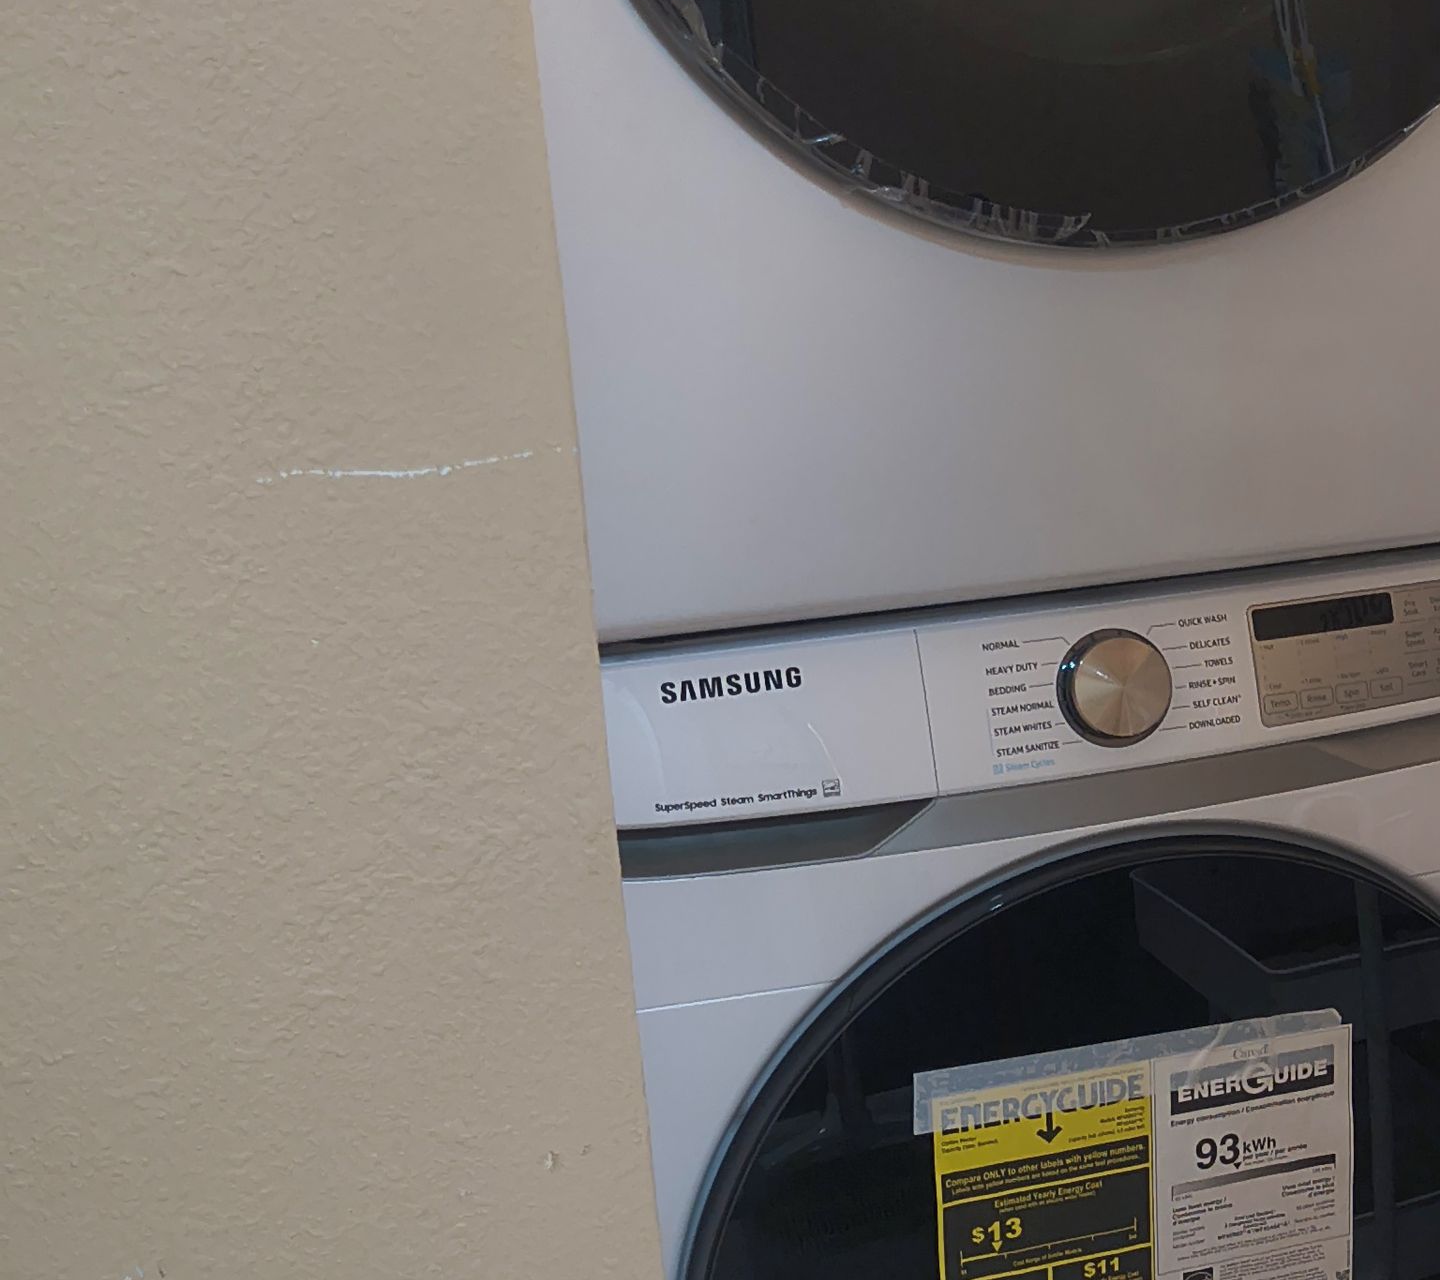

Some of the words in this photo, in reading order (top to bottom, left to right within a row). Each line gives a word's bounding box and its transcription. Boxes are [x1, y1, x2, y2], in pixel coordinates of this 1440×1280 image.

[1178, 617, 1202, 628] QUICK
[1203, 613, 1227, 624] WASH
[982, 639, 1020, 652] NORMAL
[1188, 637, 1231, 650] DELICATES
[985, 663, 1014, 676] HEAVY
[1015, 661, 1038, 673] DUTY
[1204, 656, 1234, 668] TOWELS
[660, 666, 802, 704] SAMSUNG
[988, 683, 1027, 696] BEDDING
[1188, 677, 1212, 689] RINSE
[1217, 675, 1236, 686] SPIN
[991, 704, 1018, 717] STEAM
[1019, 699, 1054, 712] NORMAL
[1192, 698, 1211, 709] SELF
[994, 724, 1021, 737] STEAM
[1022, 721, 1052, 733] WHITES
[1188, 715, 1241, 731] DOWNLOADED
[996, 745, 1024, 758] STEAM
[1025, 740, 1060, 753] SANITIZE
[655, 798, 717, 813] SuperSpeed
[720, 794, 754, 807] Steam
[757, 787, 817, 804] SmartThings
[1177, 1058, 1329, 1104] ENERGUIDE
[940, 1073, 1145, 1136] ENERGYGUIDE
[1195, 1132, 1241, 1170] 93
[1243, 1136, 1277, 1154] kWh
[945, 1173, 982, 1189] Compare
[983, 1168, 1007, 1182] ONLY
[1007, 1167, 1016, 1176] to
[1017, 1163, 1038, 1175] other
[1040, 1158, 1064, 1170] labels
[1065, 1153, 1082, 1165] with
[1083, 1149, 1108, 1163] yellow
[994, 1192, 1031, 1208] Estimated
[1033, 1187, 1057, 1203] Yearly
[1058, 1183, 1084, 1198] Energy
[1085, 1179, 1103, 1192] Cost
[971, 1217, 1023, 1244] $13
[1083, 1256, 1120, 1278] $11
